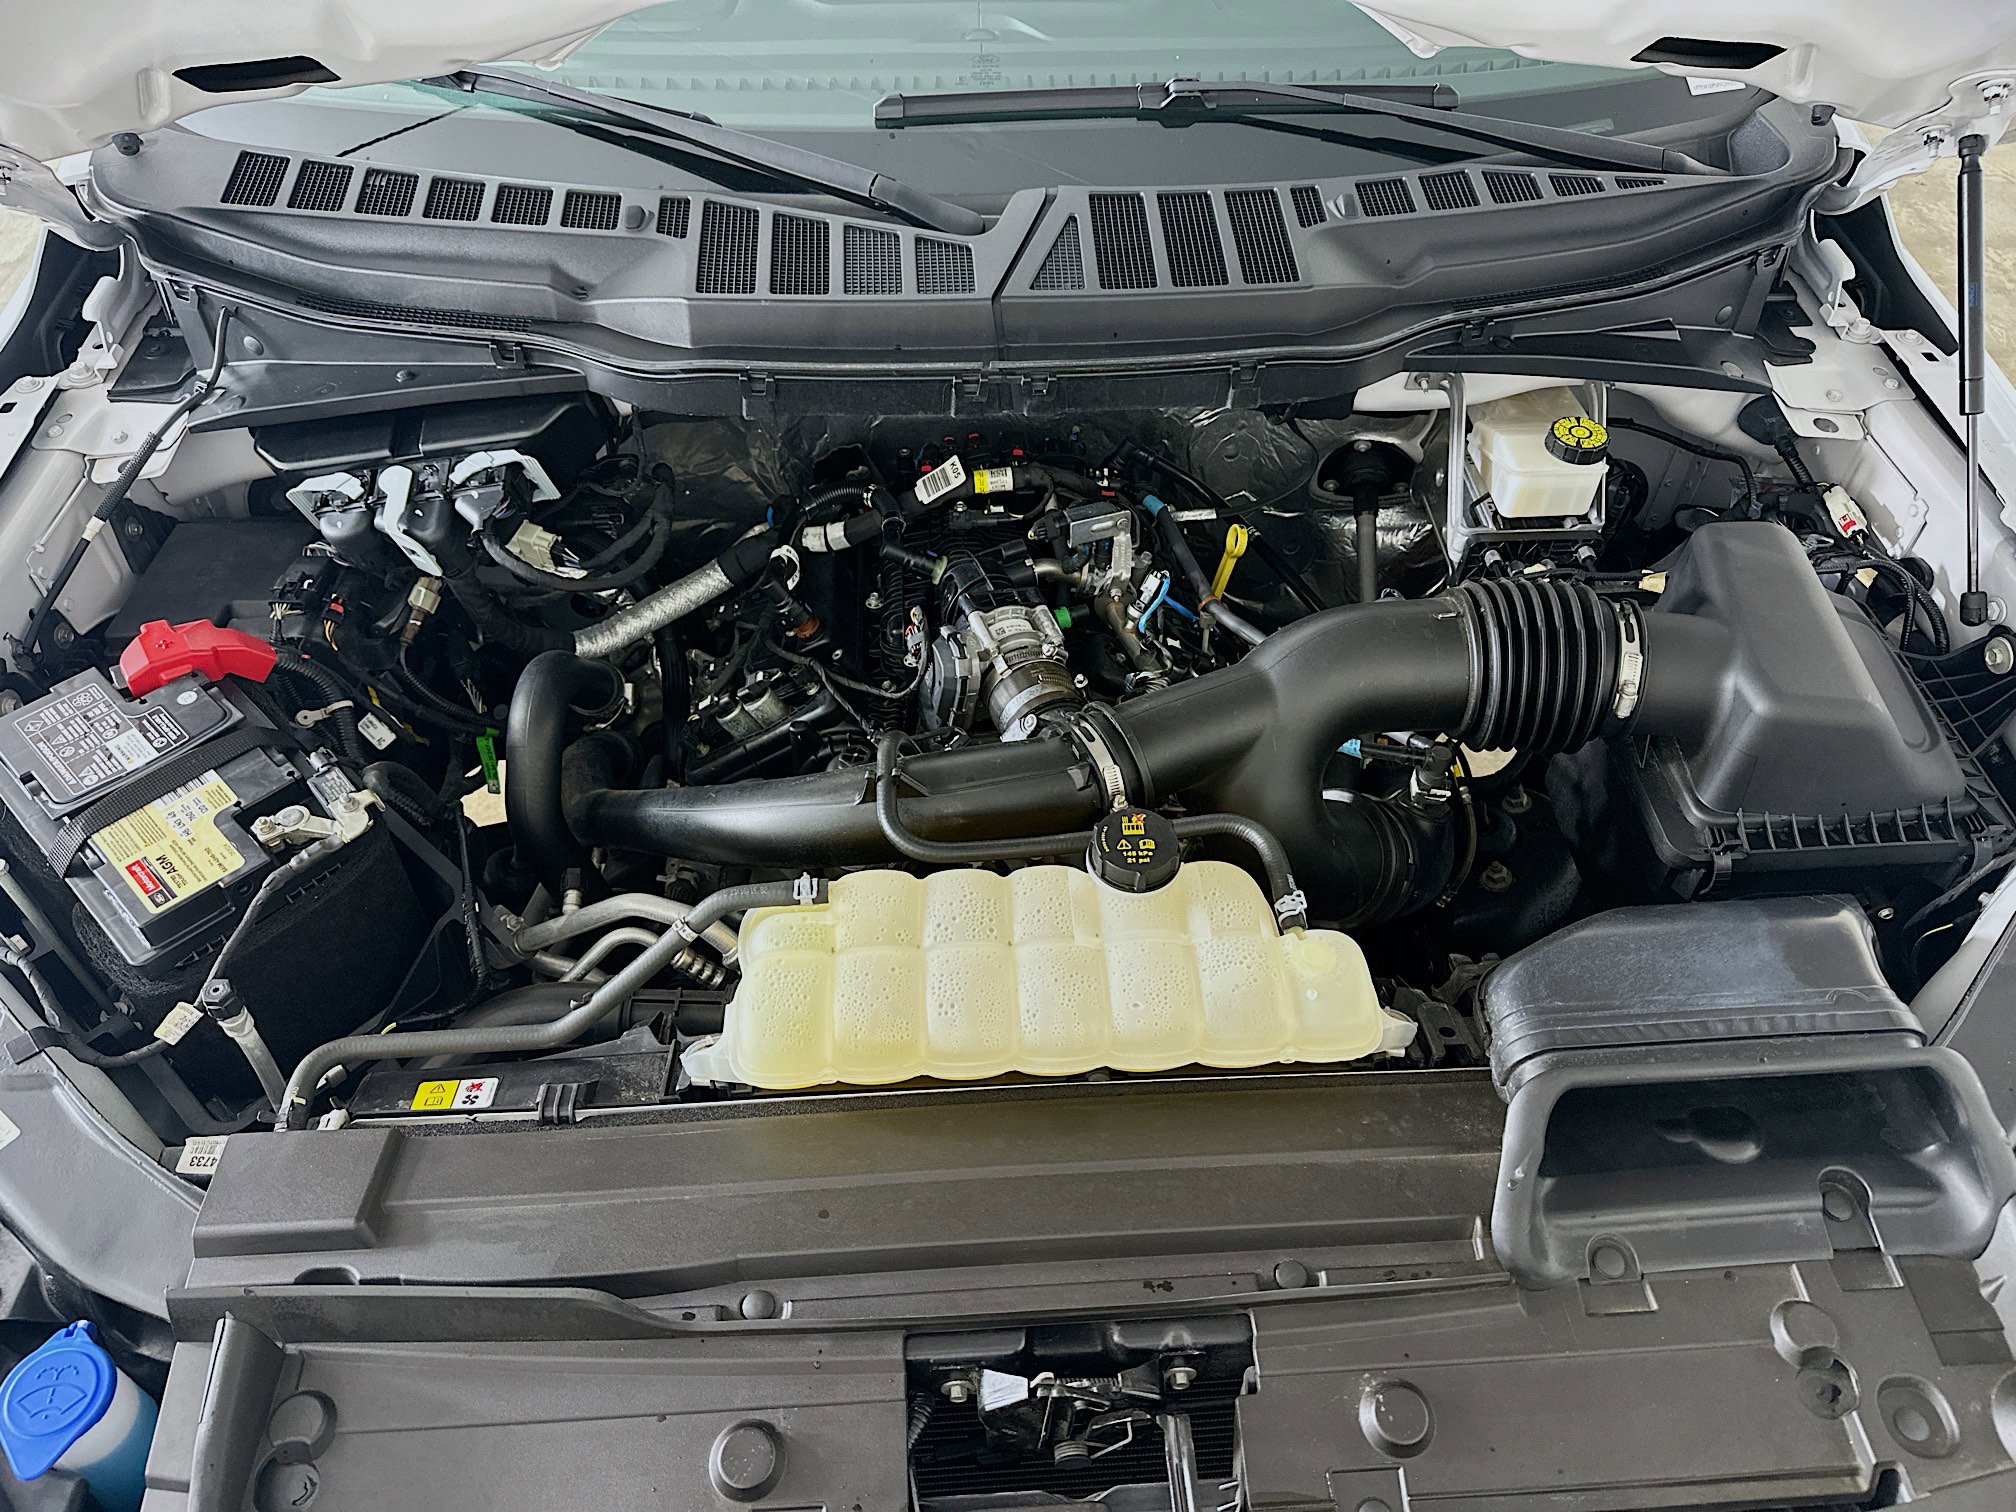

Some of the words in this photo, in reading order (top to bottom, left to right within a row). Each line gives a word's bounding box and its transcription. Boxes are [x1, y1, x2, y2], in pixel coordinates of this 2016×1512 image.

[950, 461, 961, 479] K05
[185, 811, 197, 821] 760
[198, 805, 208, 813] 120
[156, 854, 178, 874] AGM
[131, 864, 156, 891] Motorcraft
[189, 1155, 218, 1167] 4733
